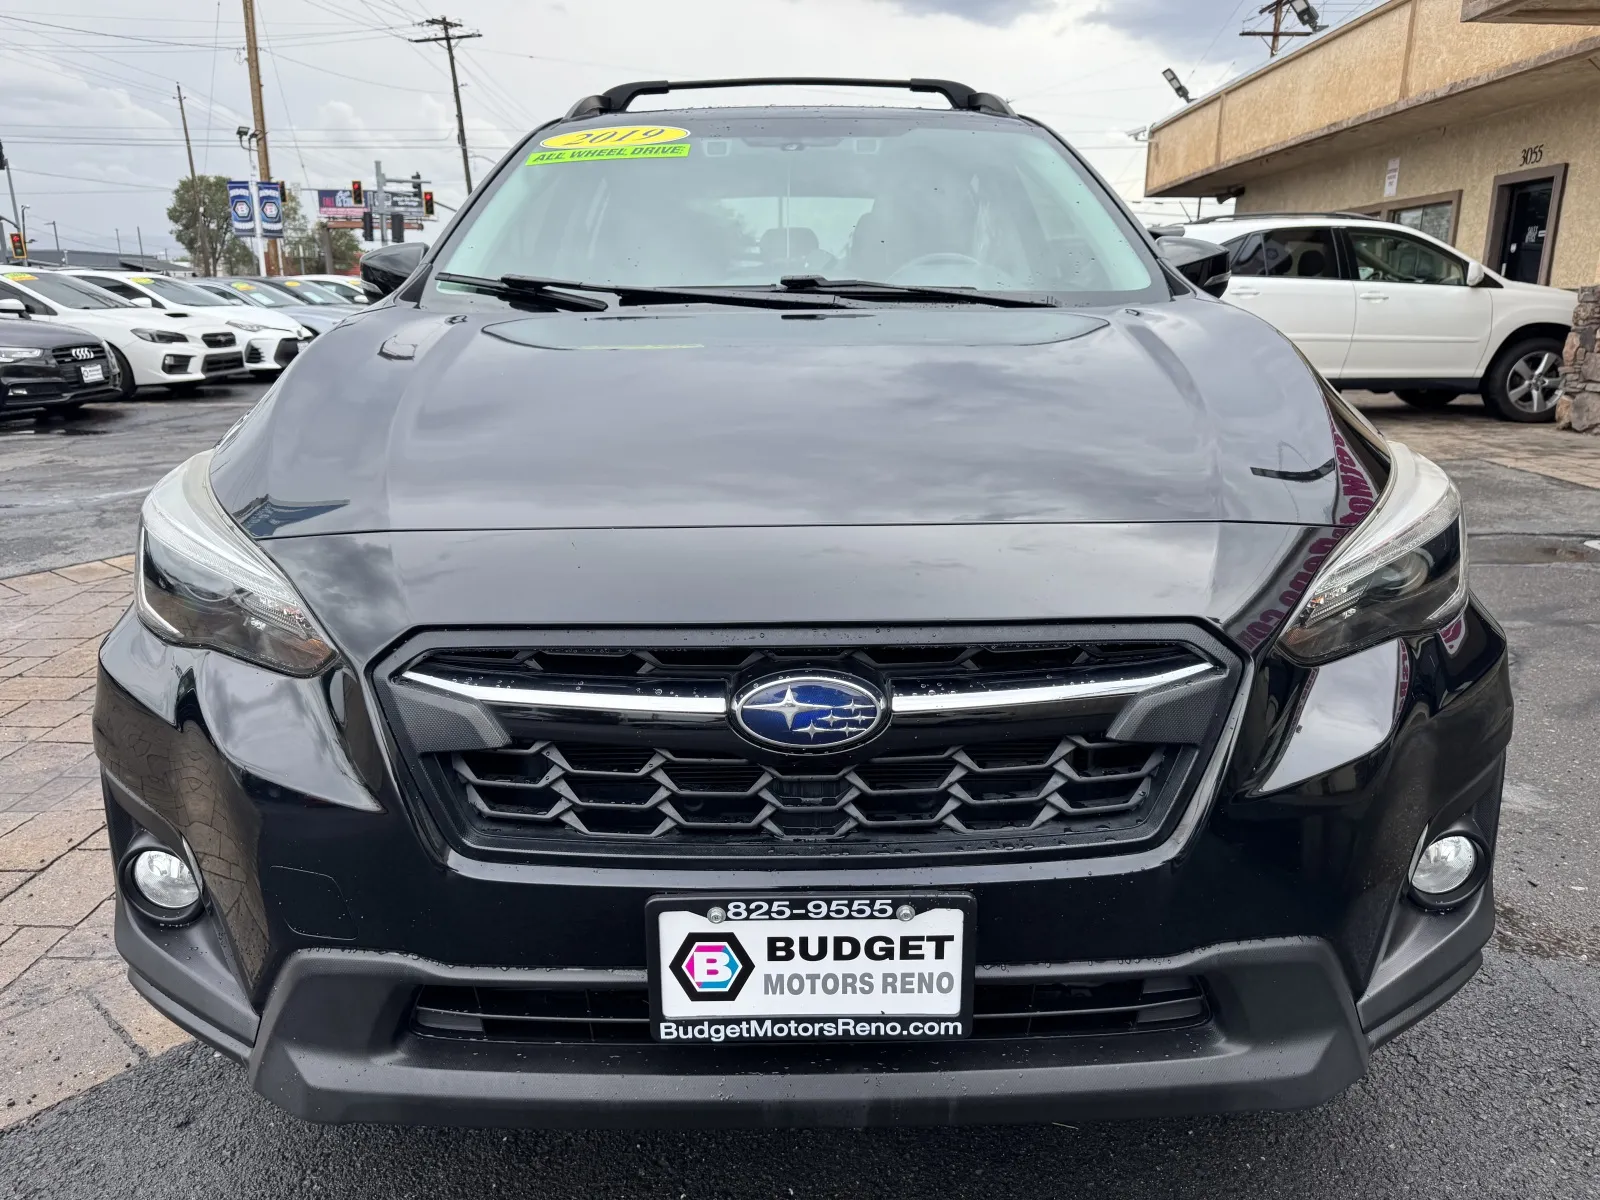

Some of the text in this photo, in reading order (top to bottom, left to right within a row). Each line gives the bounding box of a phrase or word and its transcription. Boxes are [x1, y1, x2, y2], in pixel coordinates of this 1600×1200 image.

[565, 128, 665, 145] 2019
[532, 145, 686, 162] ALL WHEEL DRIVE
[1519, 144, 1544, 167] 3055
[726, 899, 893, 920] 825-9555
[766, 935, 955, 962] BUDGET
[763, 971, 955, 996] MOTORS RENO
[659, 1018, 963, 1042] BudgetMotorsReno.com
